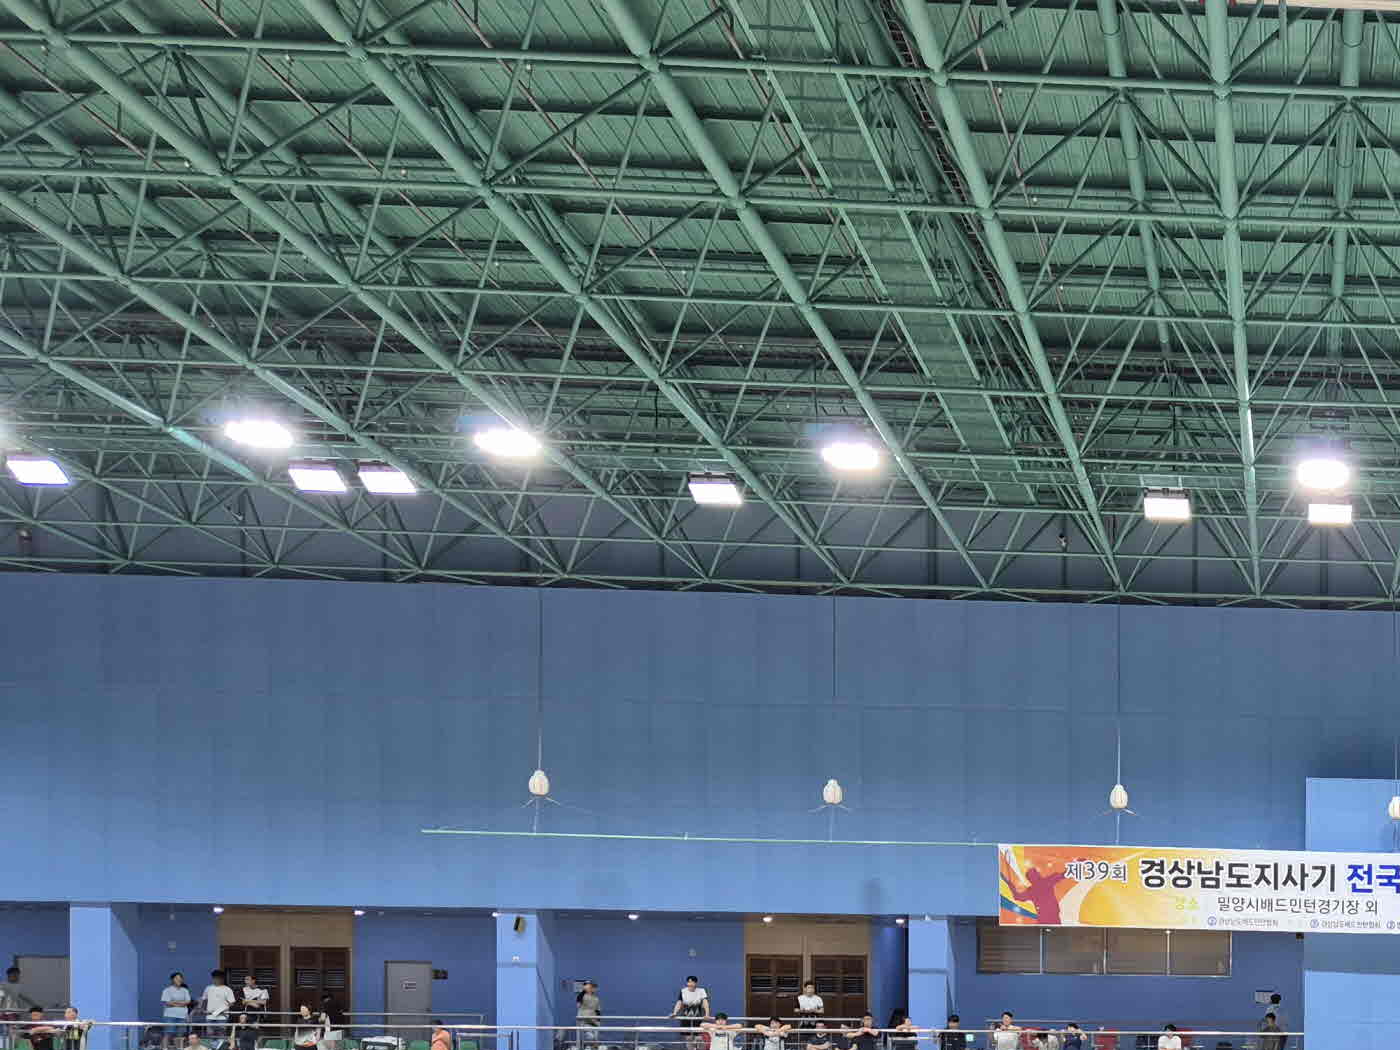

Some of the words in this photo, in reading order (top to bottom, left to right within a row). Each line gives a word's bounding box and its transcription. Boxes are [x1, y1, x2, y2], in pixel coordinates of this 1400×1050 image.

[1066, 862, 1127, 881] 제39회
[1141, 860, 1336, 892] 경상남도지사기
[1218, 896, 1359, 915] 밀양시배드민턴경기장
[1365, 900, 1378, 915] 외
